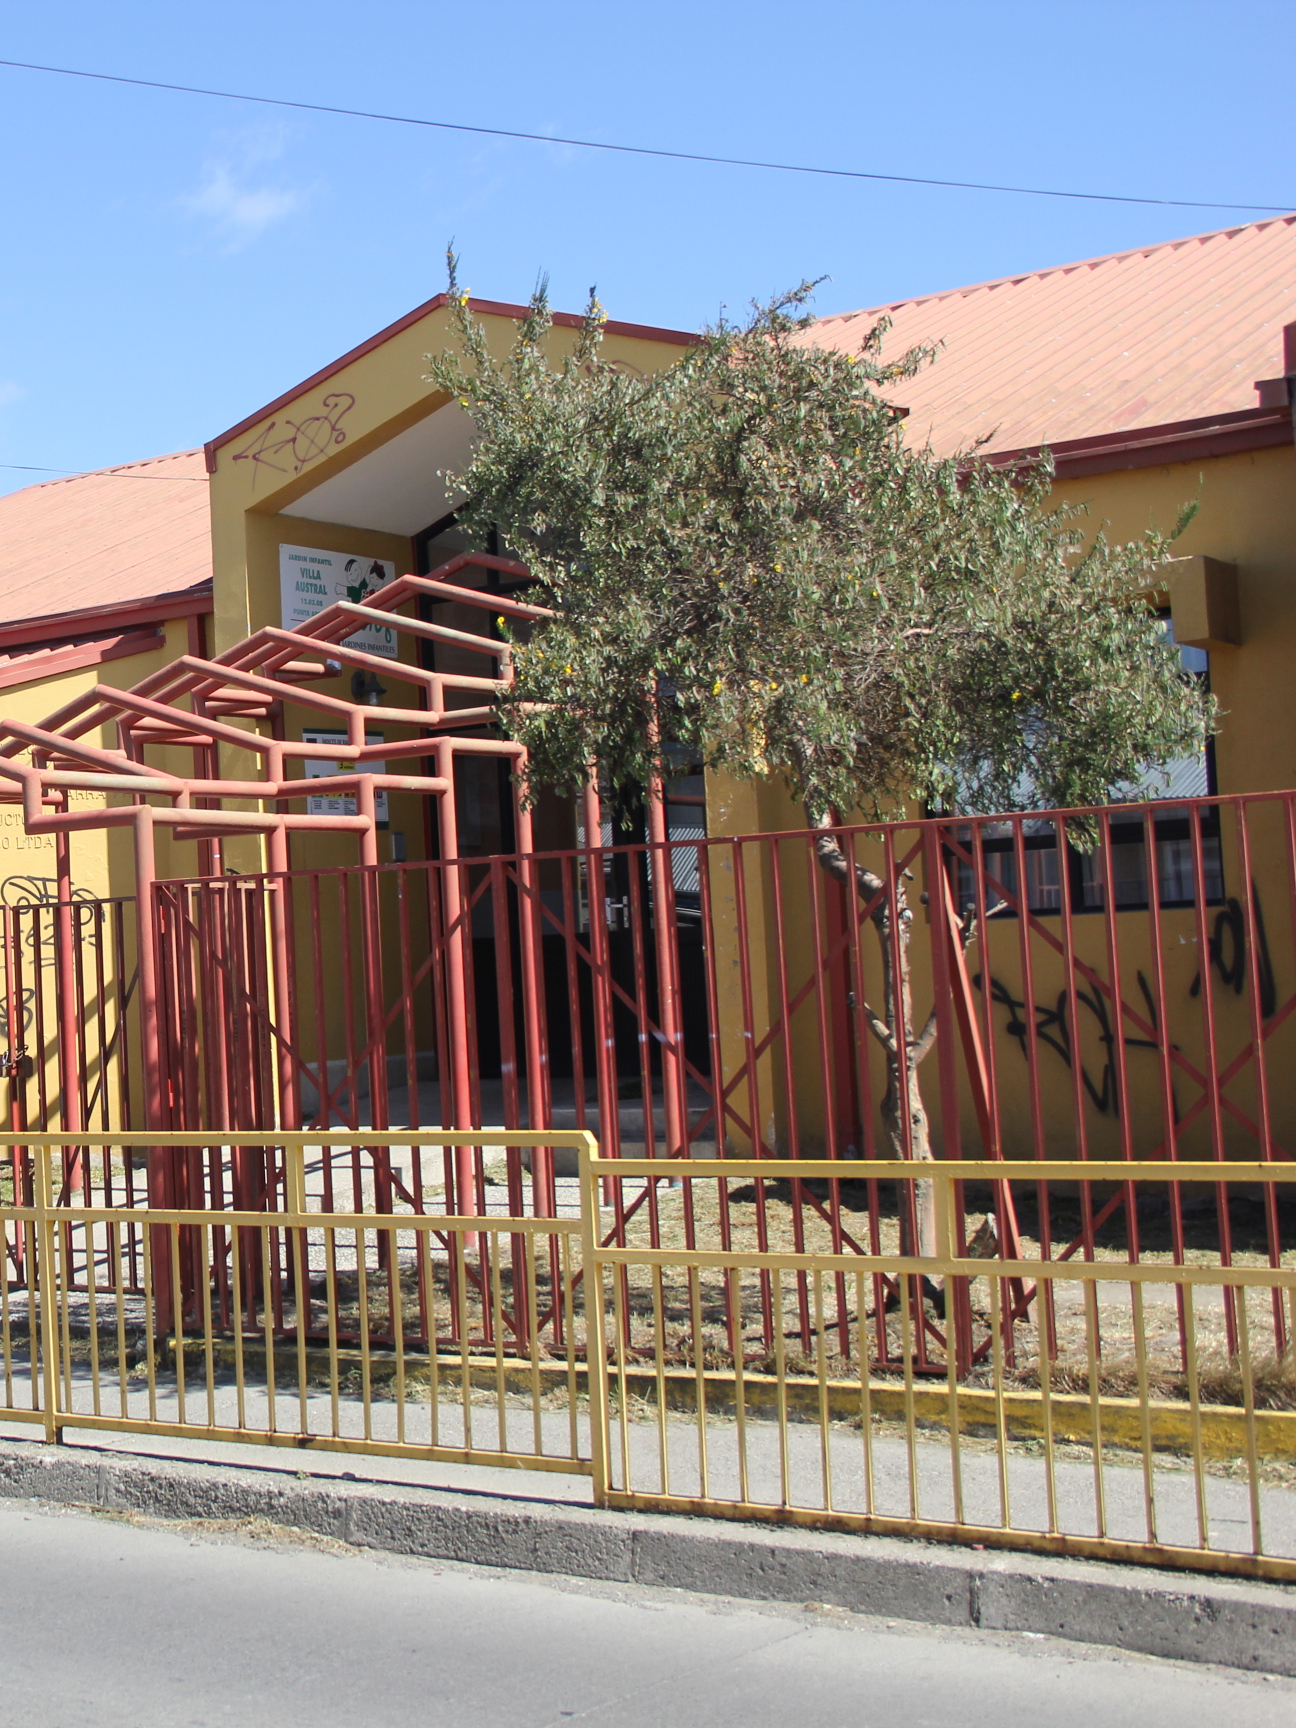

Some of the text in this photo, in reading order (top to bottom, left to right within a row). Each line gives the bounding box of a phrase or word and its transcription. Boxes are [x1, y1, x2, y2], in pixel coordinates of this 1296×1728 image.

[288, 554, 333, 566] JARDIN INFANTIL
[300, 567, 322, 581] VILLA
[295, 581, 328, 595] AUSTRAL
[16, 836, 54, 850] LTDA
